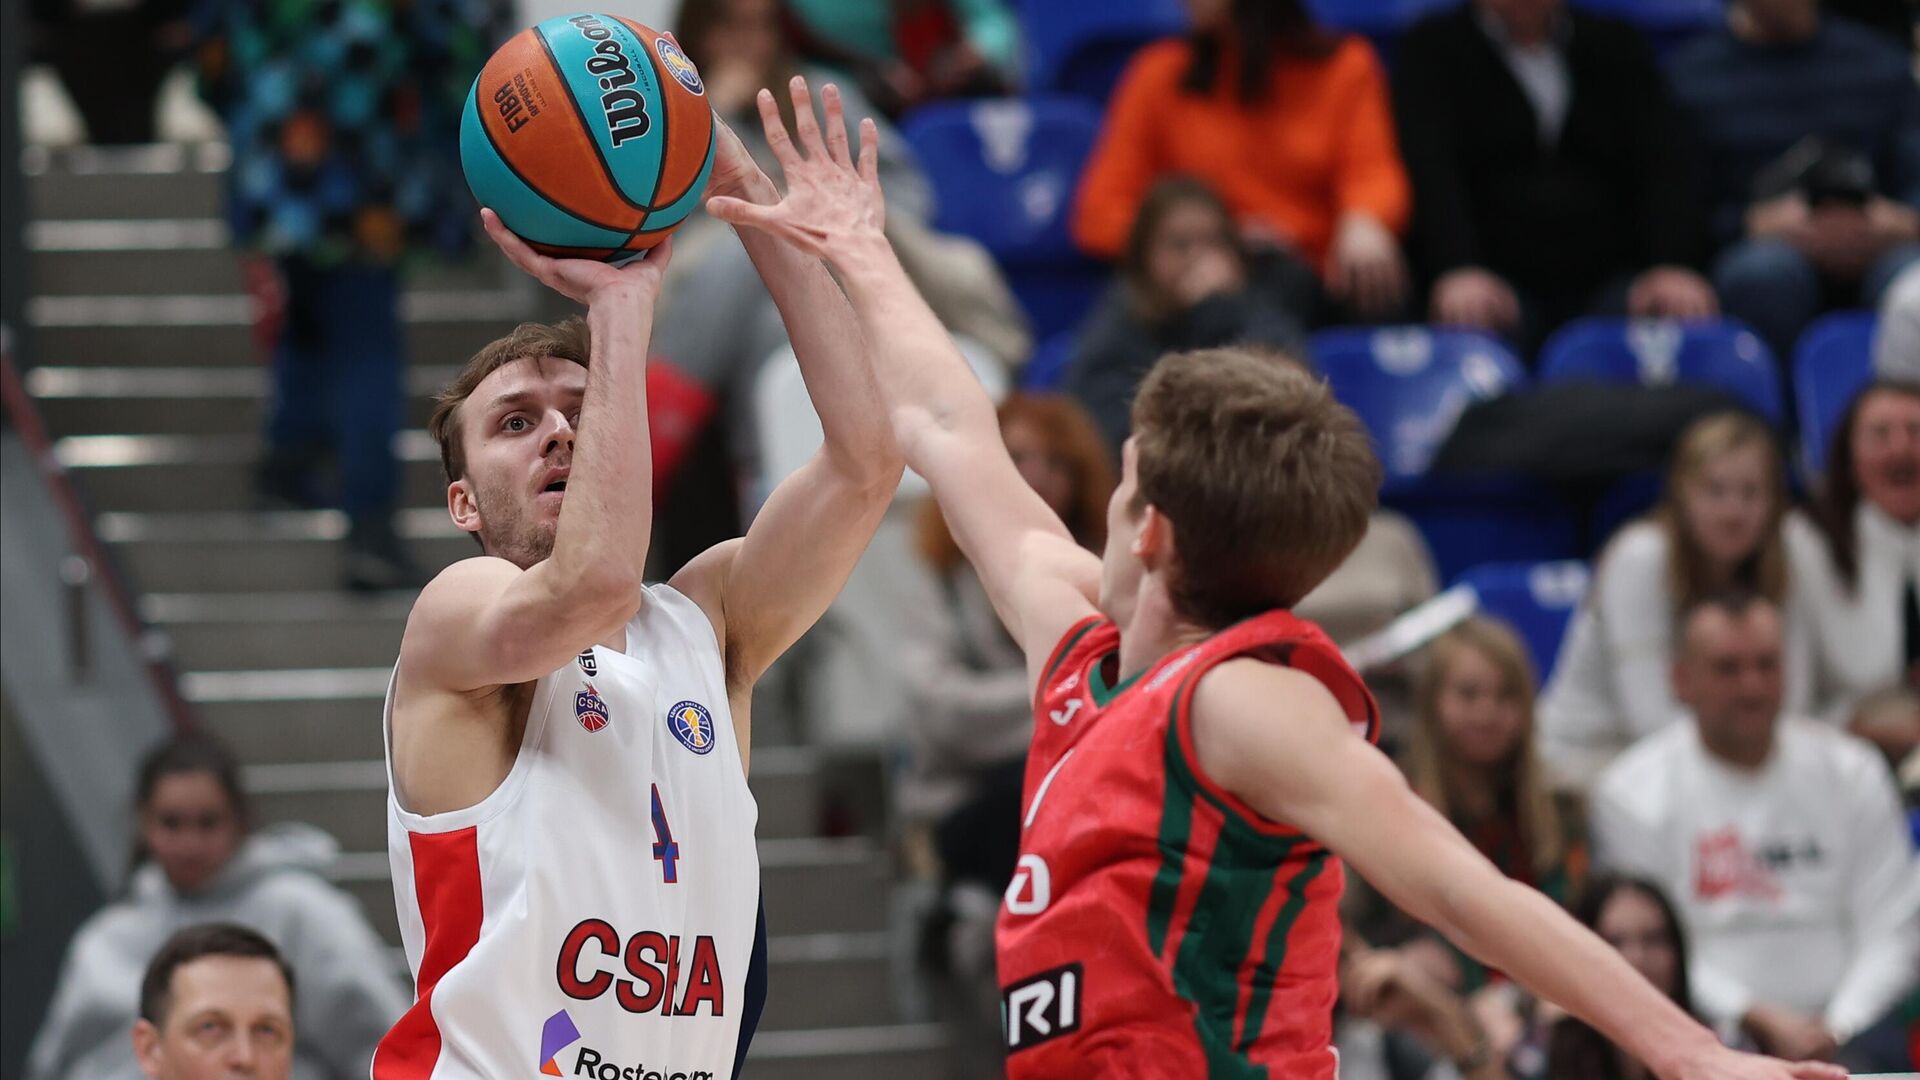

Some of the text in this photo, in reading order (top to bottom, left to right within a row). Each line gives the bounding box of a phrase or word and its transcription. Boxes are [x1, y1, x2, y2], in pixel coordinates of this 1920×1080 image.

[513, 73, 540, 118] APPROVED
[567, 14, 650, 148] Wilson
[494, 82, 529, 133] FIBA
[578, 697, 607, 714] CSKA
